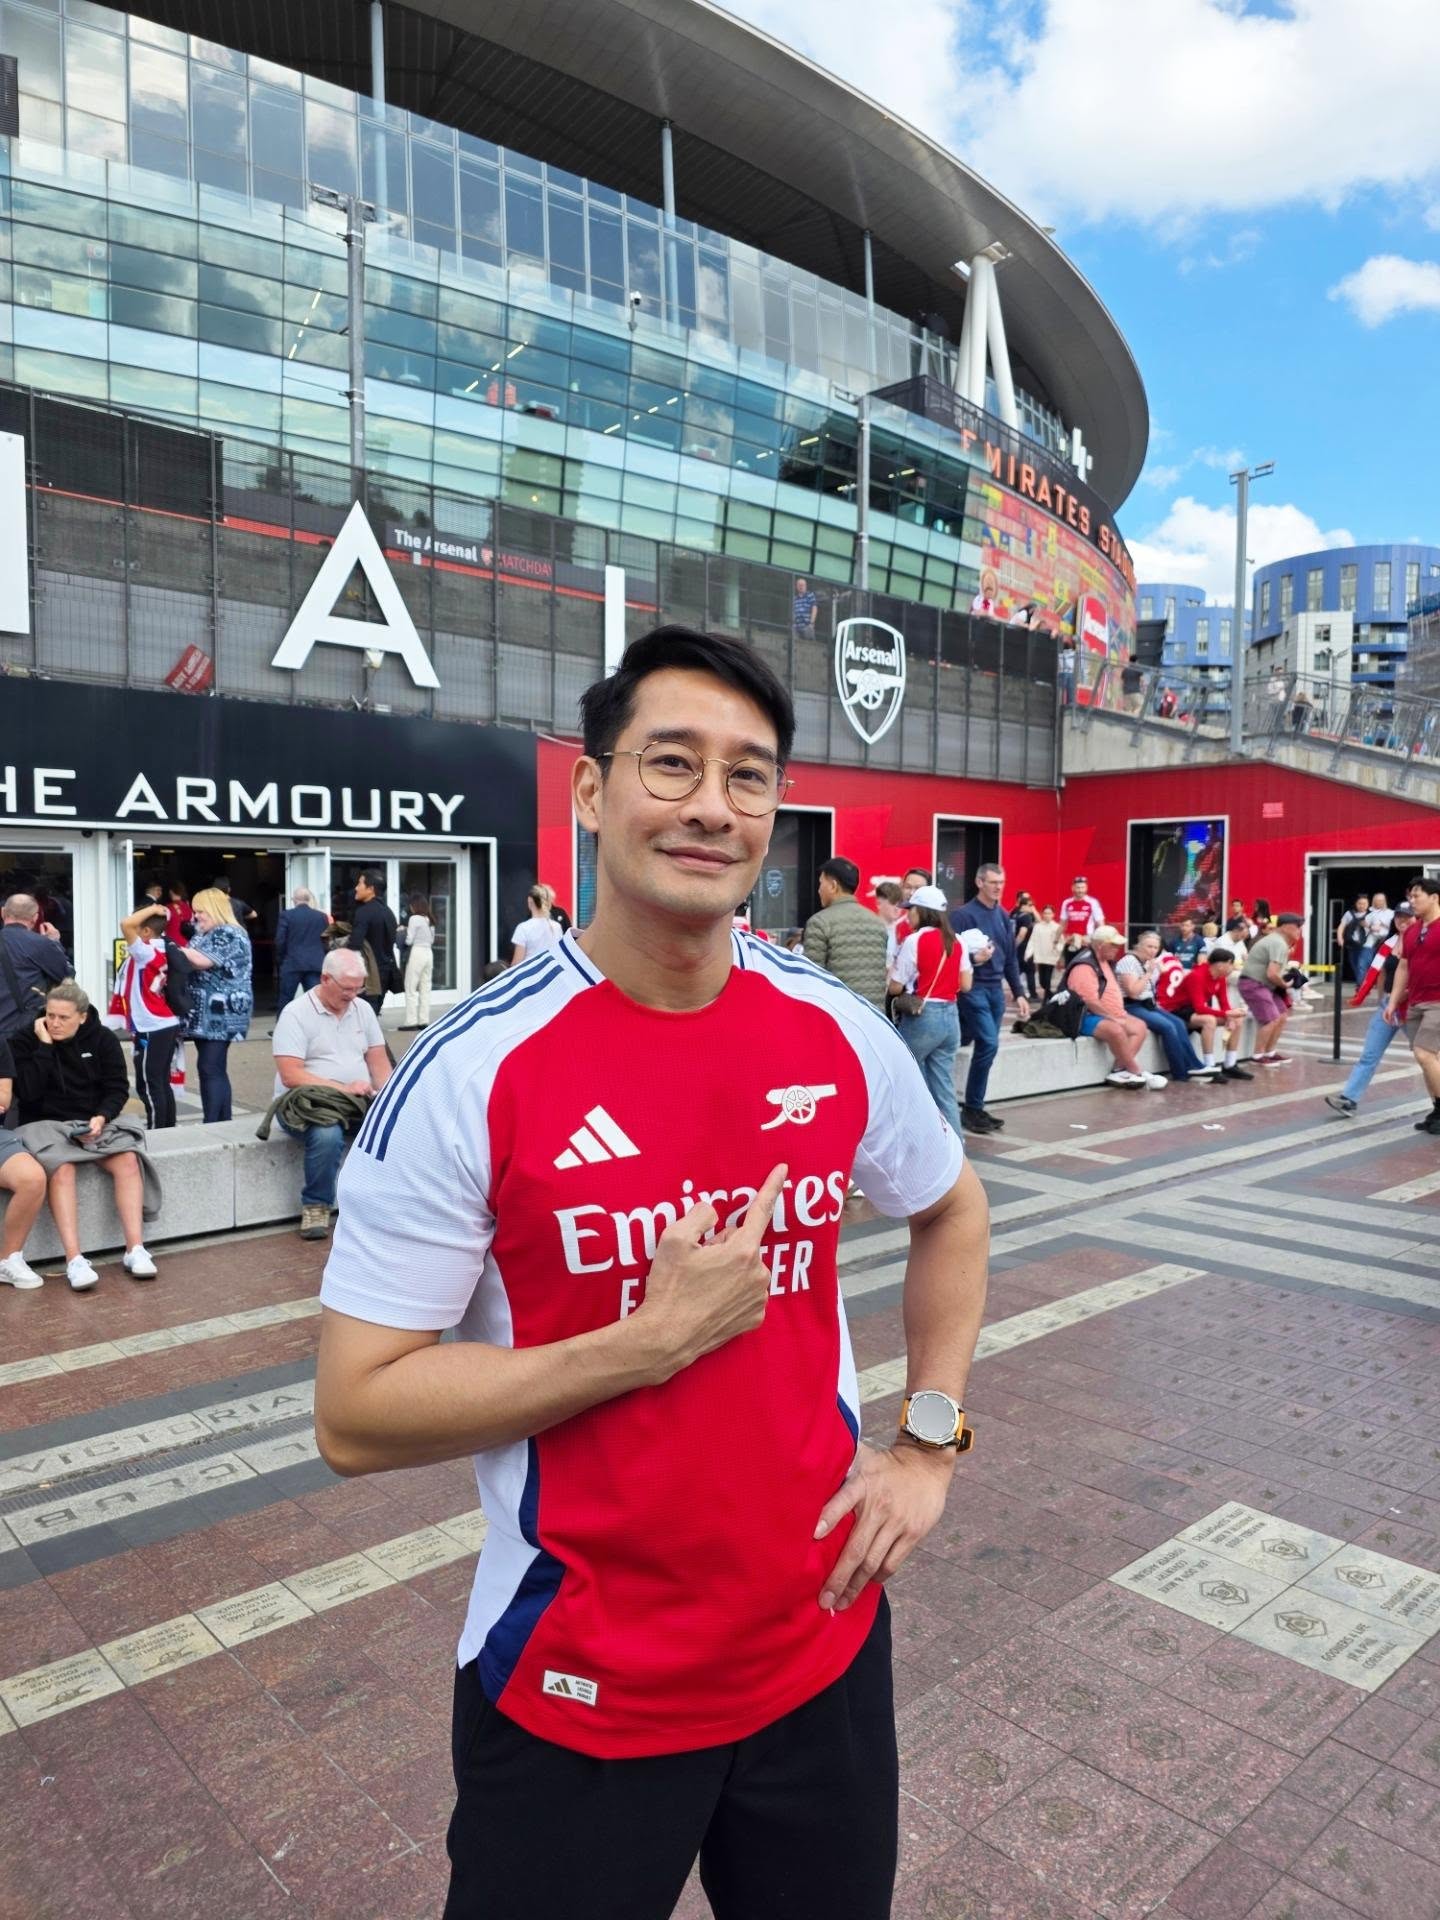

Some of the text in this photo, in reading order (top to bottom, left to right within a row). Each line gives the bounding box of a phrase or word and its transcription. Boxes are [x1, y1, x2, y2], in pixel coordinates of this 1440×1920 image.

[394, 529, 552, 576] The Arsenal MATCHDA
[845, 640, 897, 667] Arsenal
[115, 772, 465, 832] ARMOURY
[15, 1394, 302, 1473] VICTORIA
